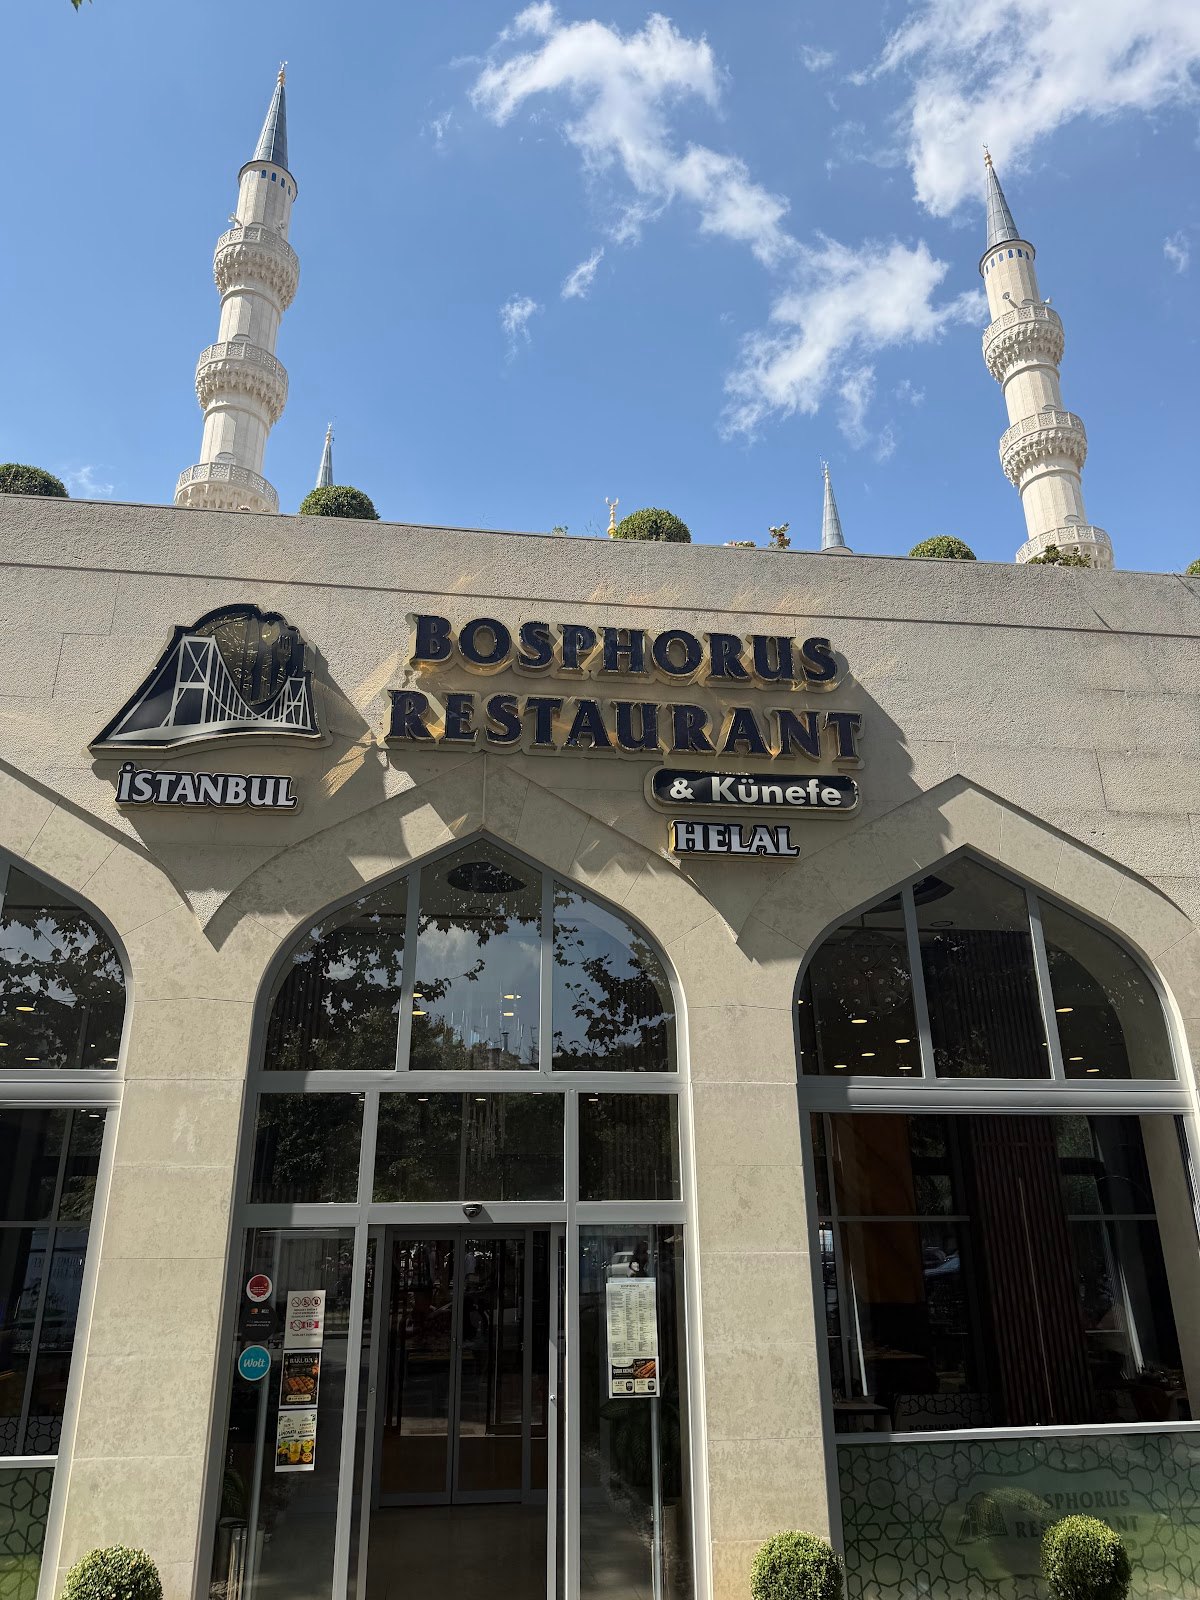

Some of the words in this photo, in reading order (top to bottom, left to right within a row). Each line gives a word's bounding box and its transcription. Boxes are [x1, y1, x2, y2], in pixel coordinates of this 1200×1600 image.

[413, 614, 838, 682] BOSPHORUS
[387, 689, 863, 762] RESTAURANT
[669, 778, 694, 800] &
[710, 775, 843, 807] Künefe
[675, 821, 799, 856] HELAL
[243, 1357, 266, 1368] Wolt
[1018, 1489, 1131, 1511] SPHORUS
